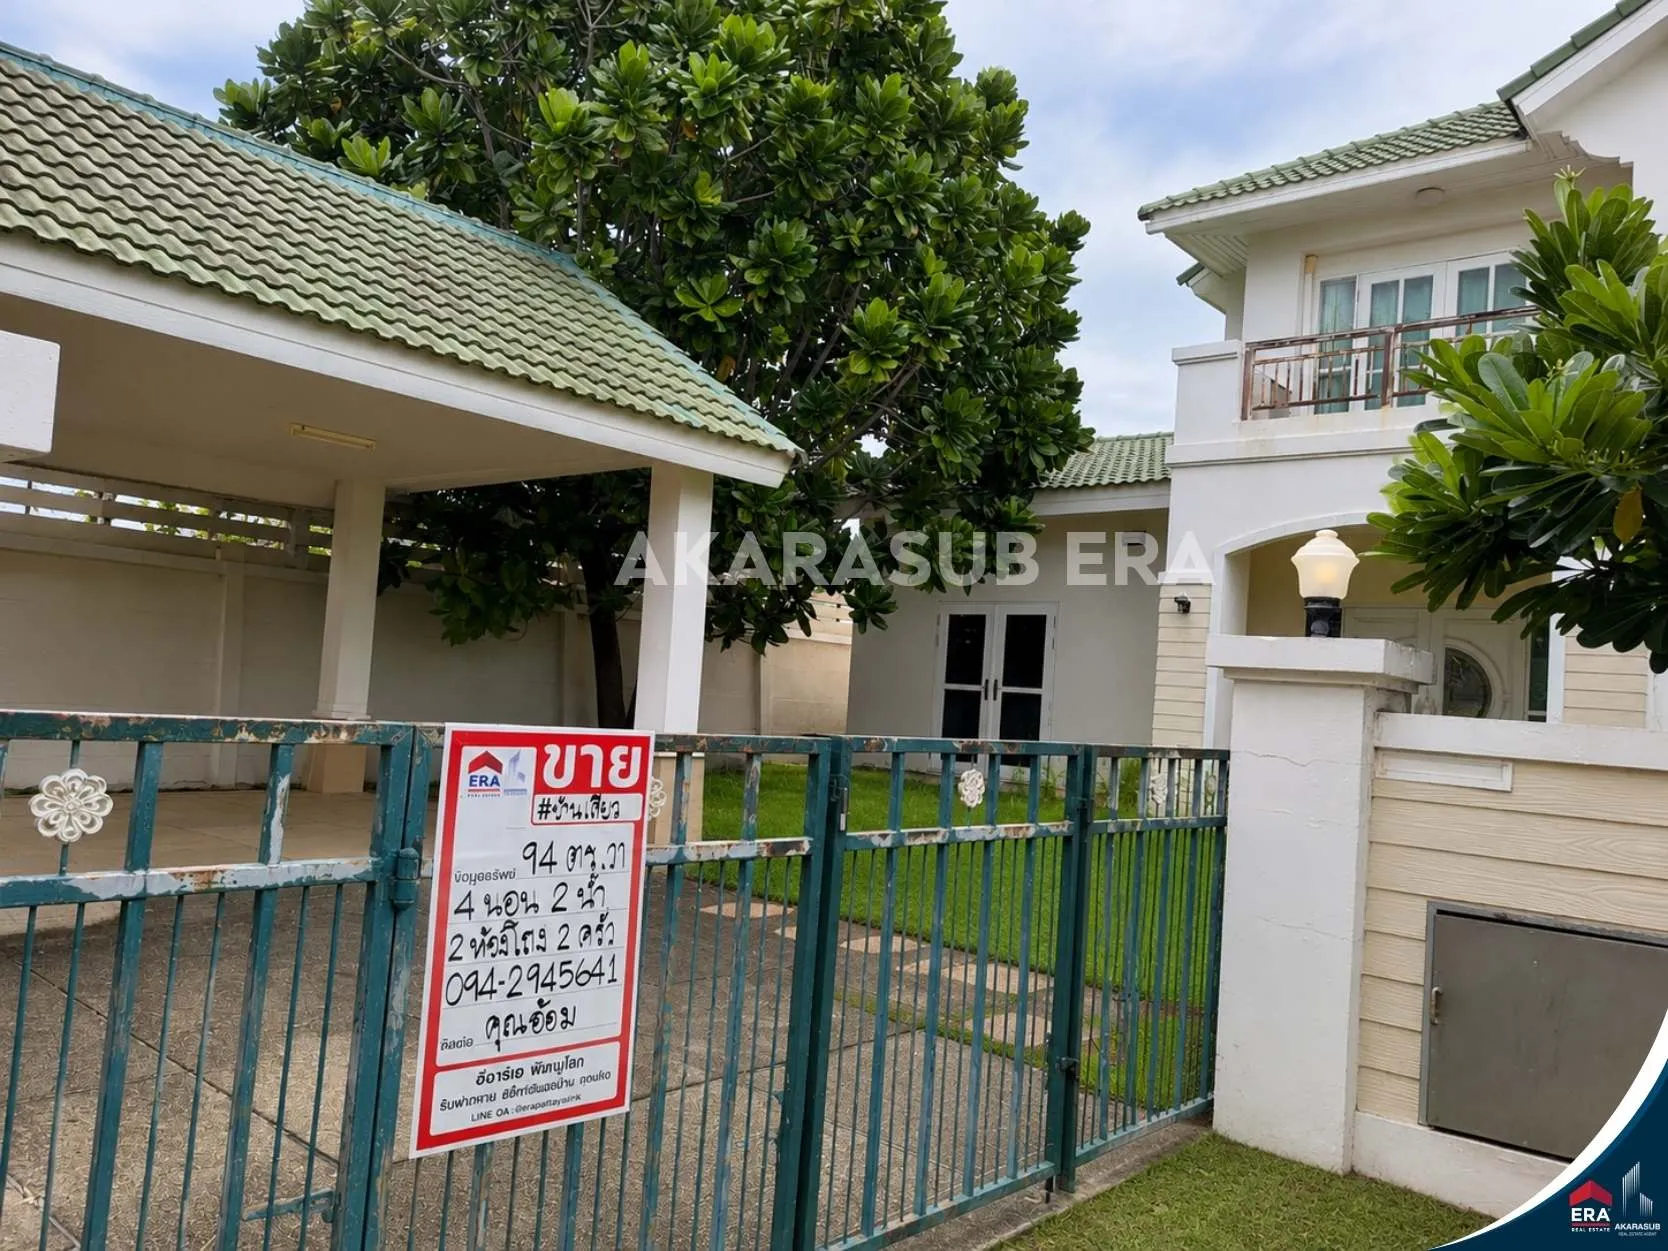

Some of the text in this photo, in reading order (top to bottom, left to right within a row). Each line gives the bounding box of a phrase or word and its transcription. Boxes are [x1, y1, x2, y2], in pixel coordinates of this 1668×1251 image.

[469, 774, 501, 788] ERA
[543, 743, 642, 789] ขาย
[522, 840, 557, 875] 94
[453, 889, 475, 921] 4
[484, 889, 540, 918] นอน
[551, 882, 569, 914] 2
[447, 933, 464, 962] 2
[557, 923, 570, 951] 2
[445, 953, 618, 1006] 094-2945641
[485, 997, 577, 1052] คุณอ้อม
[471, 1107, 510, 1122] LINE OA
